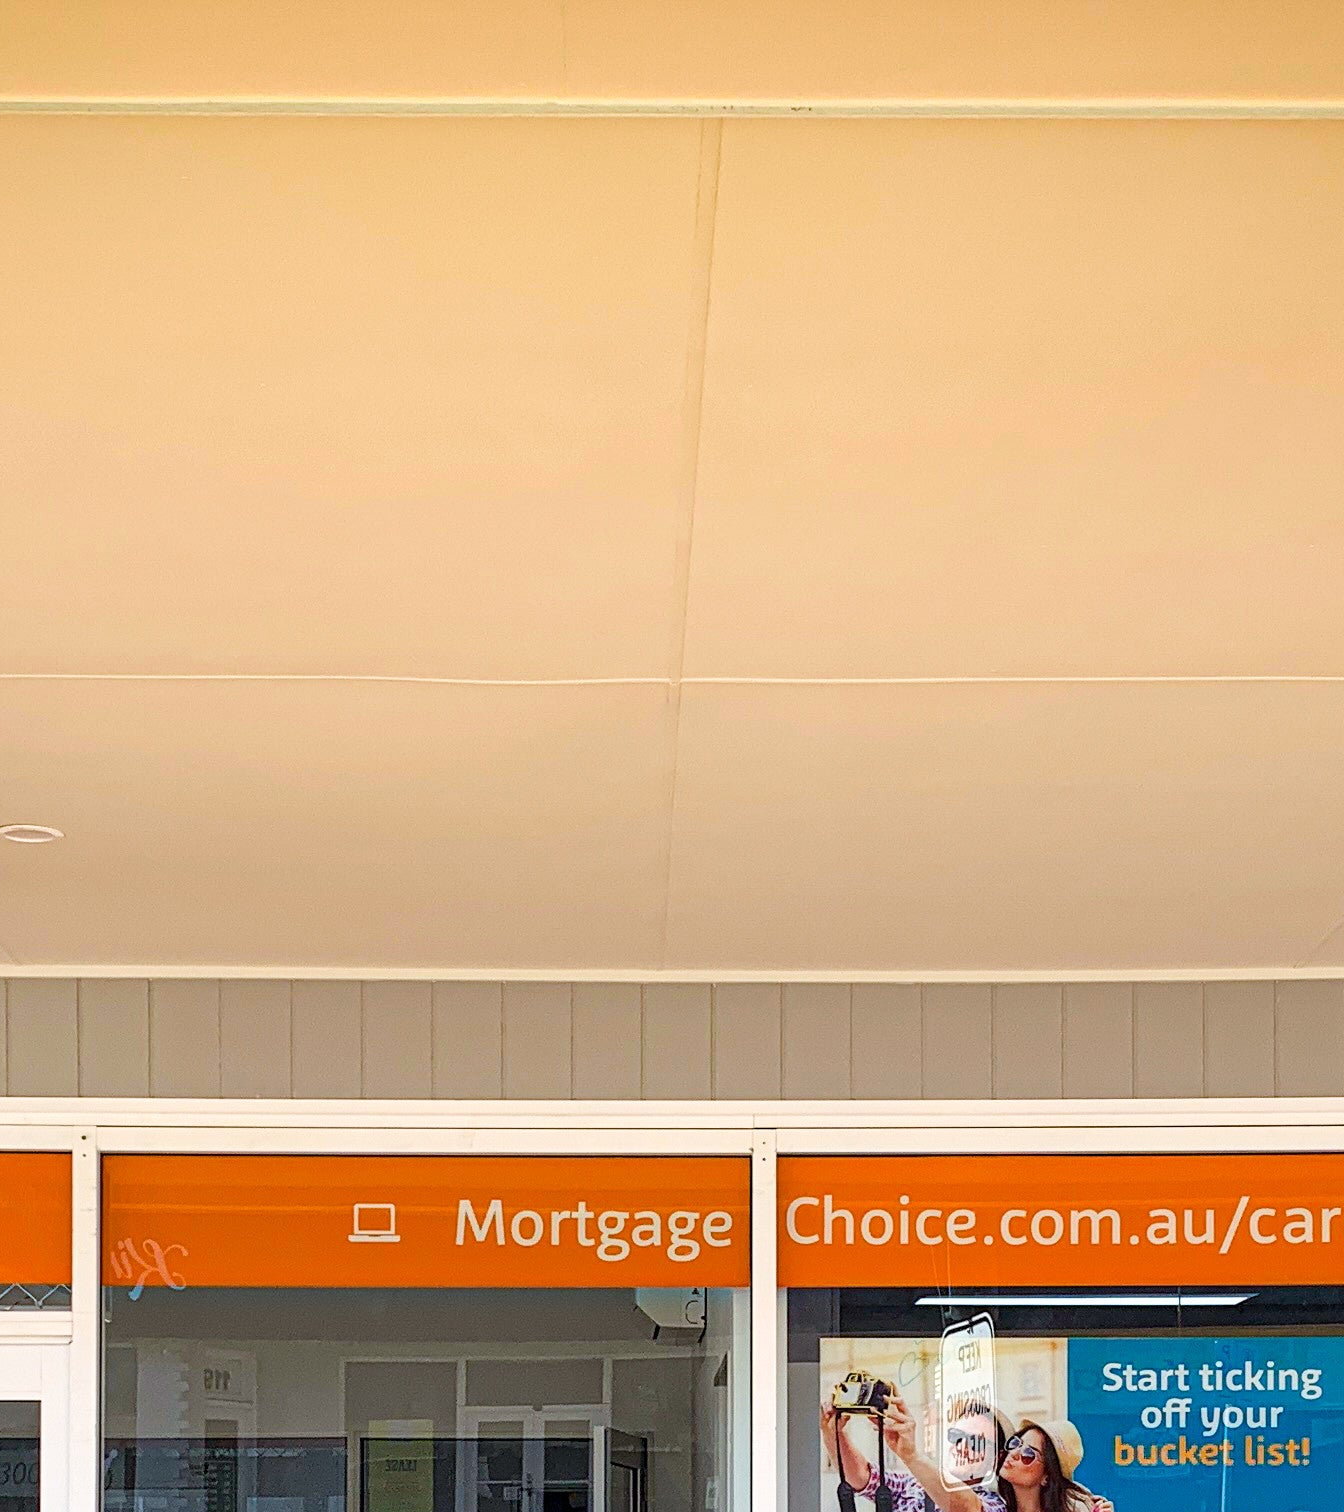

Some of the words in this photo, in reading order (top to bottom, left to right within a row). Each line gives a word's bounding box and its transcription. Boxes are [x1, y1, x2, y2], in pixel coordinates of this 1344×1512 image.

[456, 1200, 732, 1261] Mortgage
[1103, 1363, 1189, 1391] Start
[1199, 1361, 1322, 1399] ticking
[1141, 1398, 1192, 1428] off
[1201, 1407, 1283, 1436] your
[1115, 1432, 1233, 1466] bucket
[1245, 1436, 1309, 1465] list!
